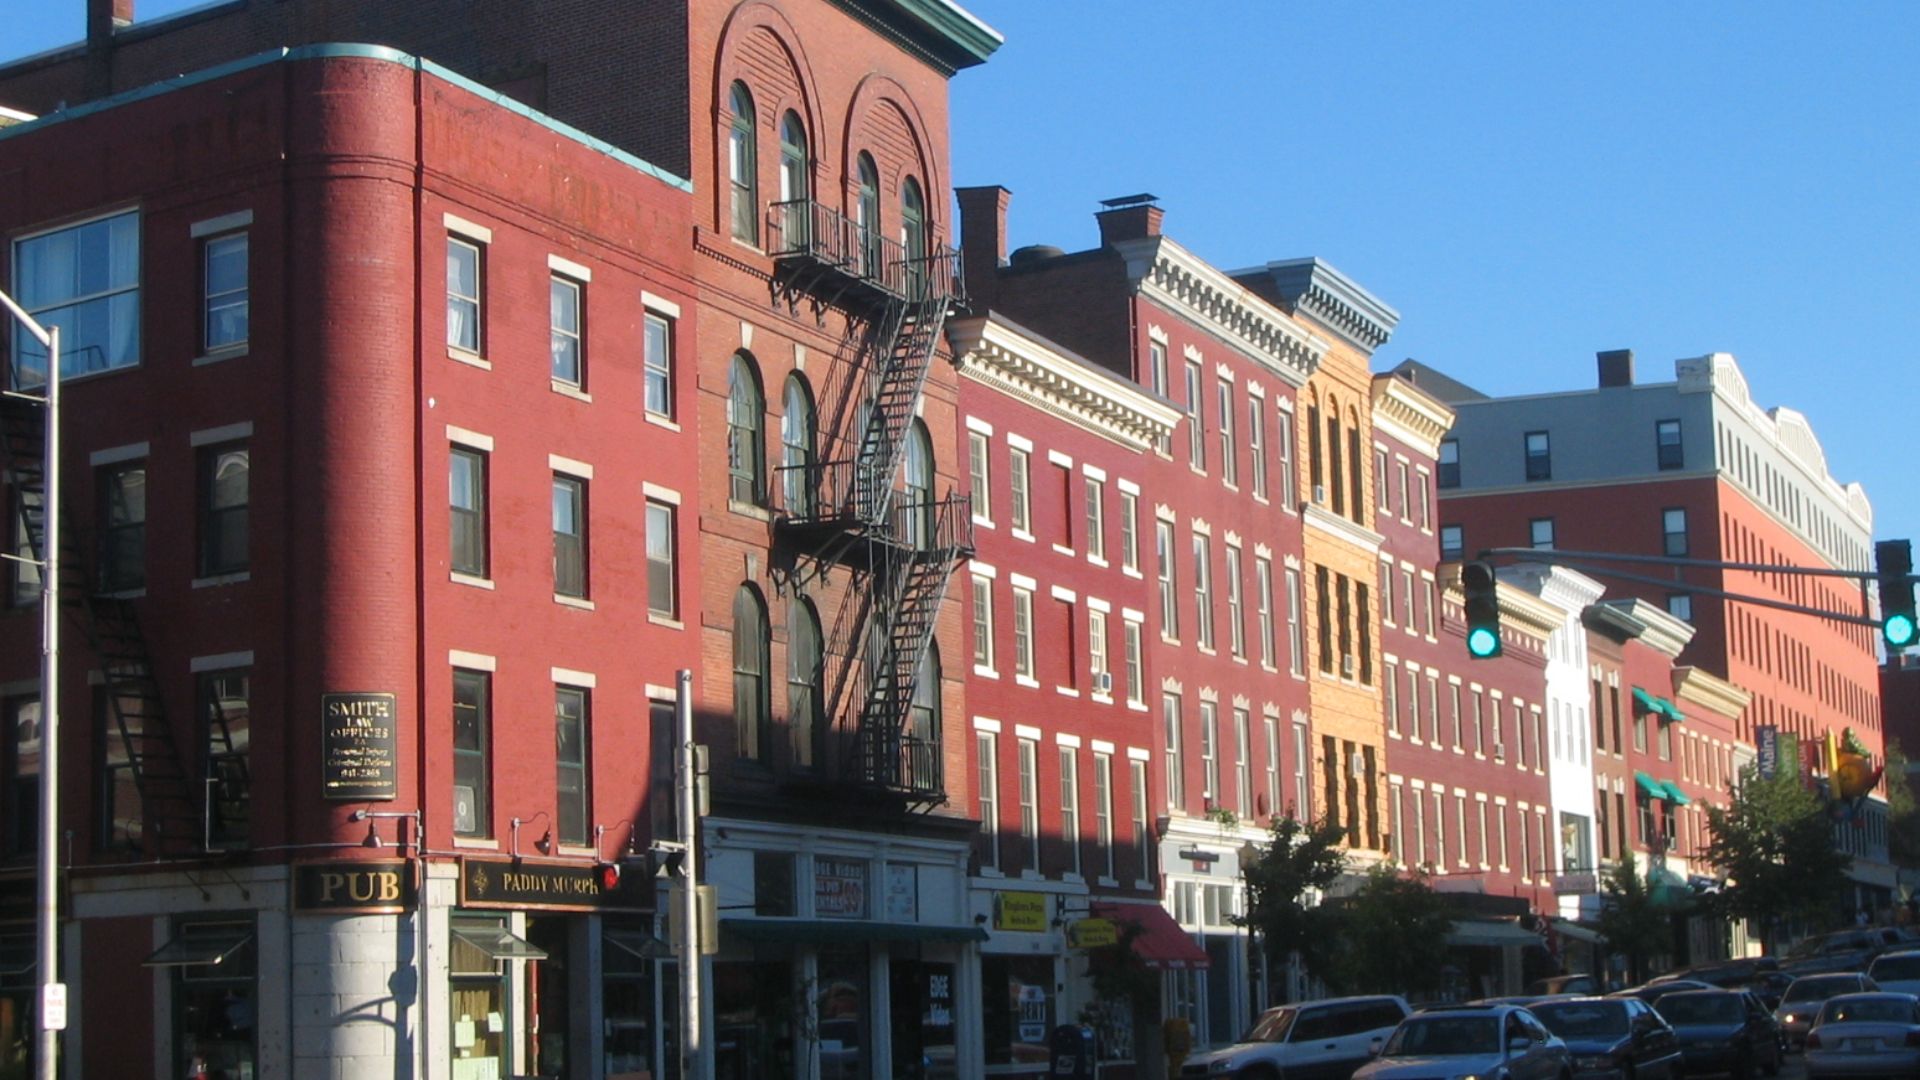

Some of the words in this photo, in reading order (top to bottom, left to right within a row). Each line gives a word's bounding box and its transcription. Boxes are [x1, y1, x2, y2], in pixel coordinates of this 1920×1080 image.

[329, 701, 388, 717] SMITH
[346, 717, 374, 728] LAW
[330, 728, 388, 739] OFFICES
[1761, 729, 1775, 773] Maine
[320, 872, 399, 901] PUB
[503, 872, 548, 893] PADDY
